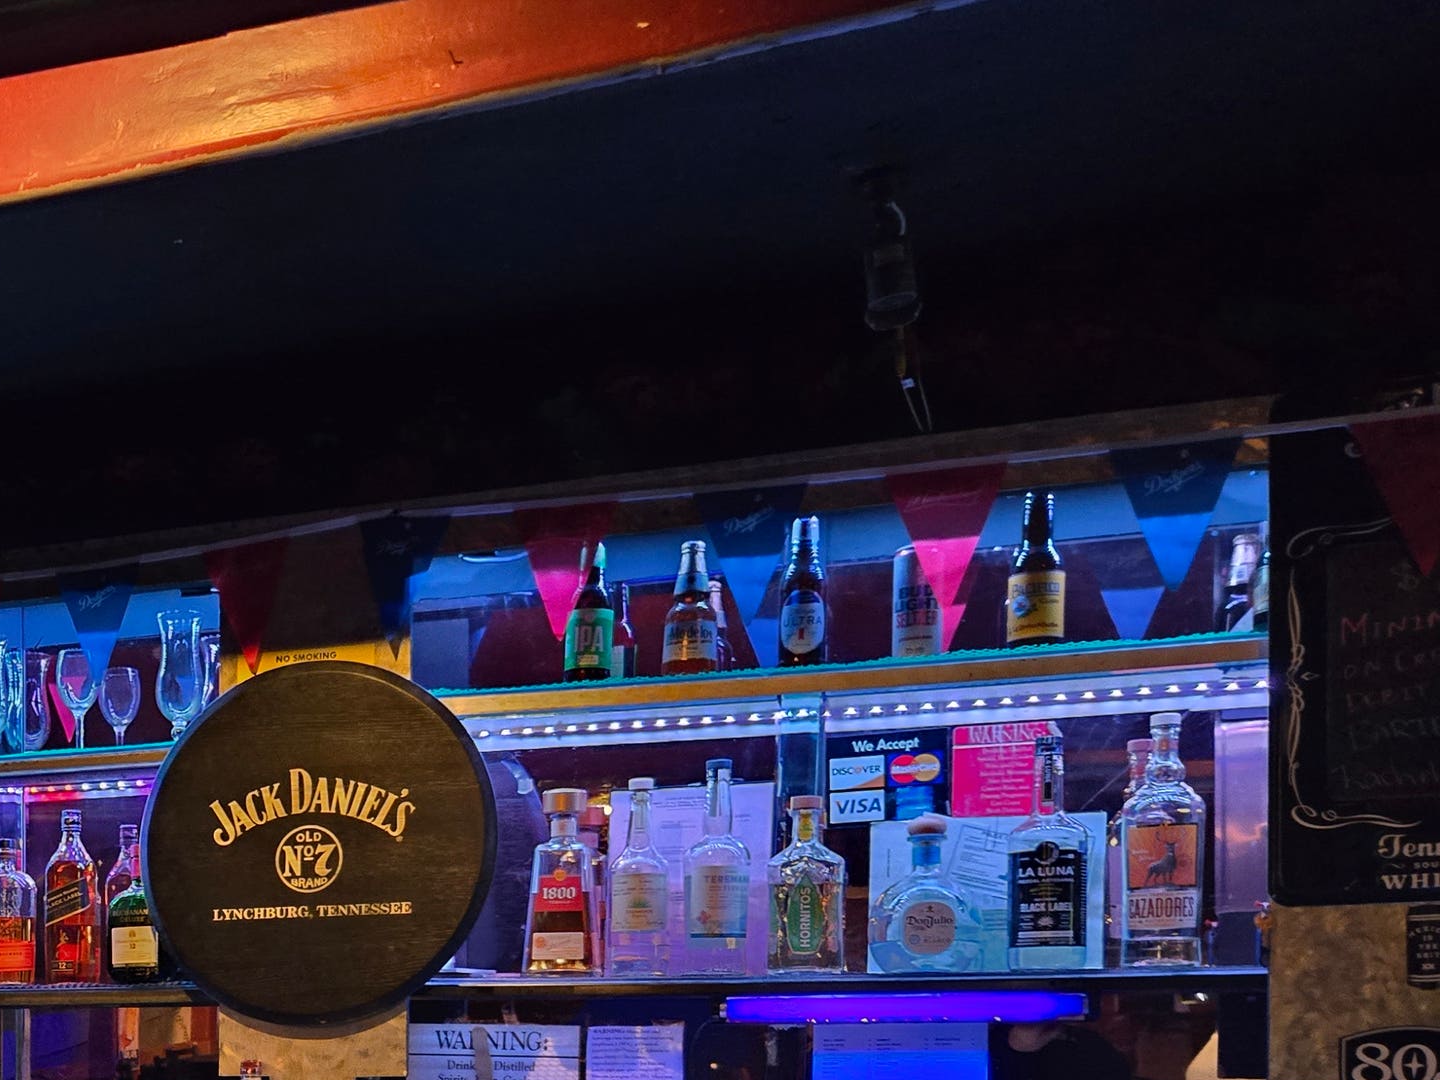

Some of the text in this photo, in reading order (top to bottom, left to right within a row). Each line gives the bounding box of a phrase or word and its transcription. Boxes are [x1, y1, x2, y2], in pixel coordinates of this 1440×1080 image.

[574, 625, 604, 653] IPA
[275, 651, 337, 664] NO SMOKING
[851, 737, 921, 753] We Accept
[832, 765, 881, 776] DISCOVER
[836, 798, 882, 815] VISA
[209, 782, 288, 847] JACK
[295, 830, 322, 843] OLD
[1017, 866, 1075, 878] LA LUNA
[290, 877, 329, 889] BRAND
[542, 886, 577, 900] 1800
[212, 901, 413, 921] LYNCHBURG, TENNESSEE
[1019, 902, 1074, 913] BLACK LABEL
[1129, 897, 1194, 919] CAZADORES
[799, 886, 811, 948] HORNITOS
[58, 961, 67, 969] 12
[435, 1029, 550, 1052] WANING:
[447, 1060, 536, 1073] Drink Distilled
